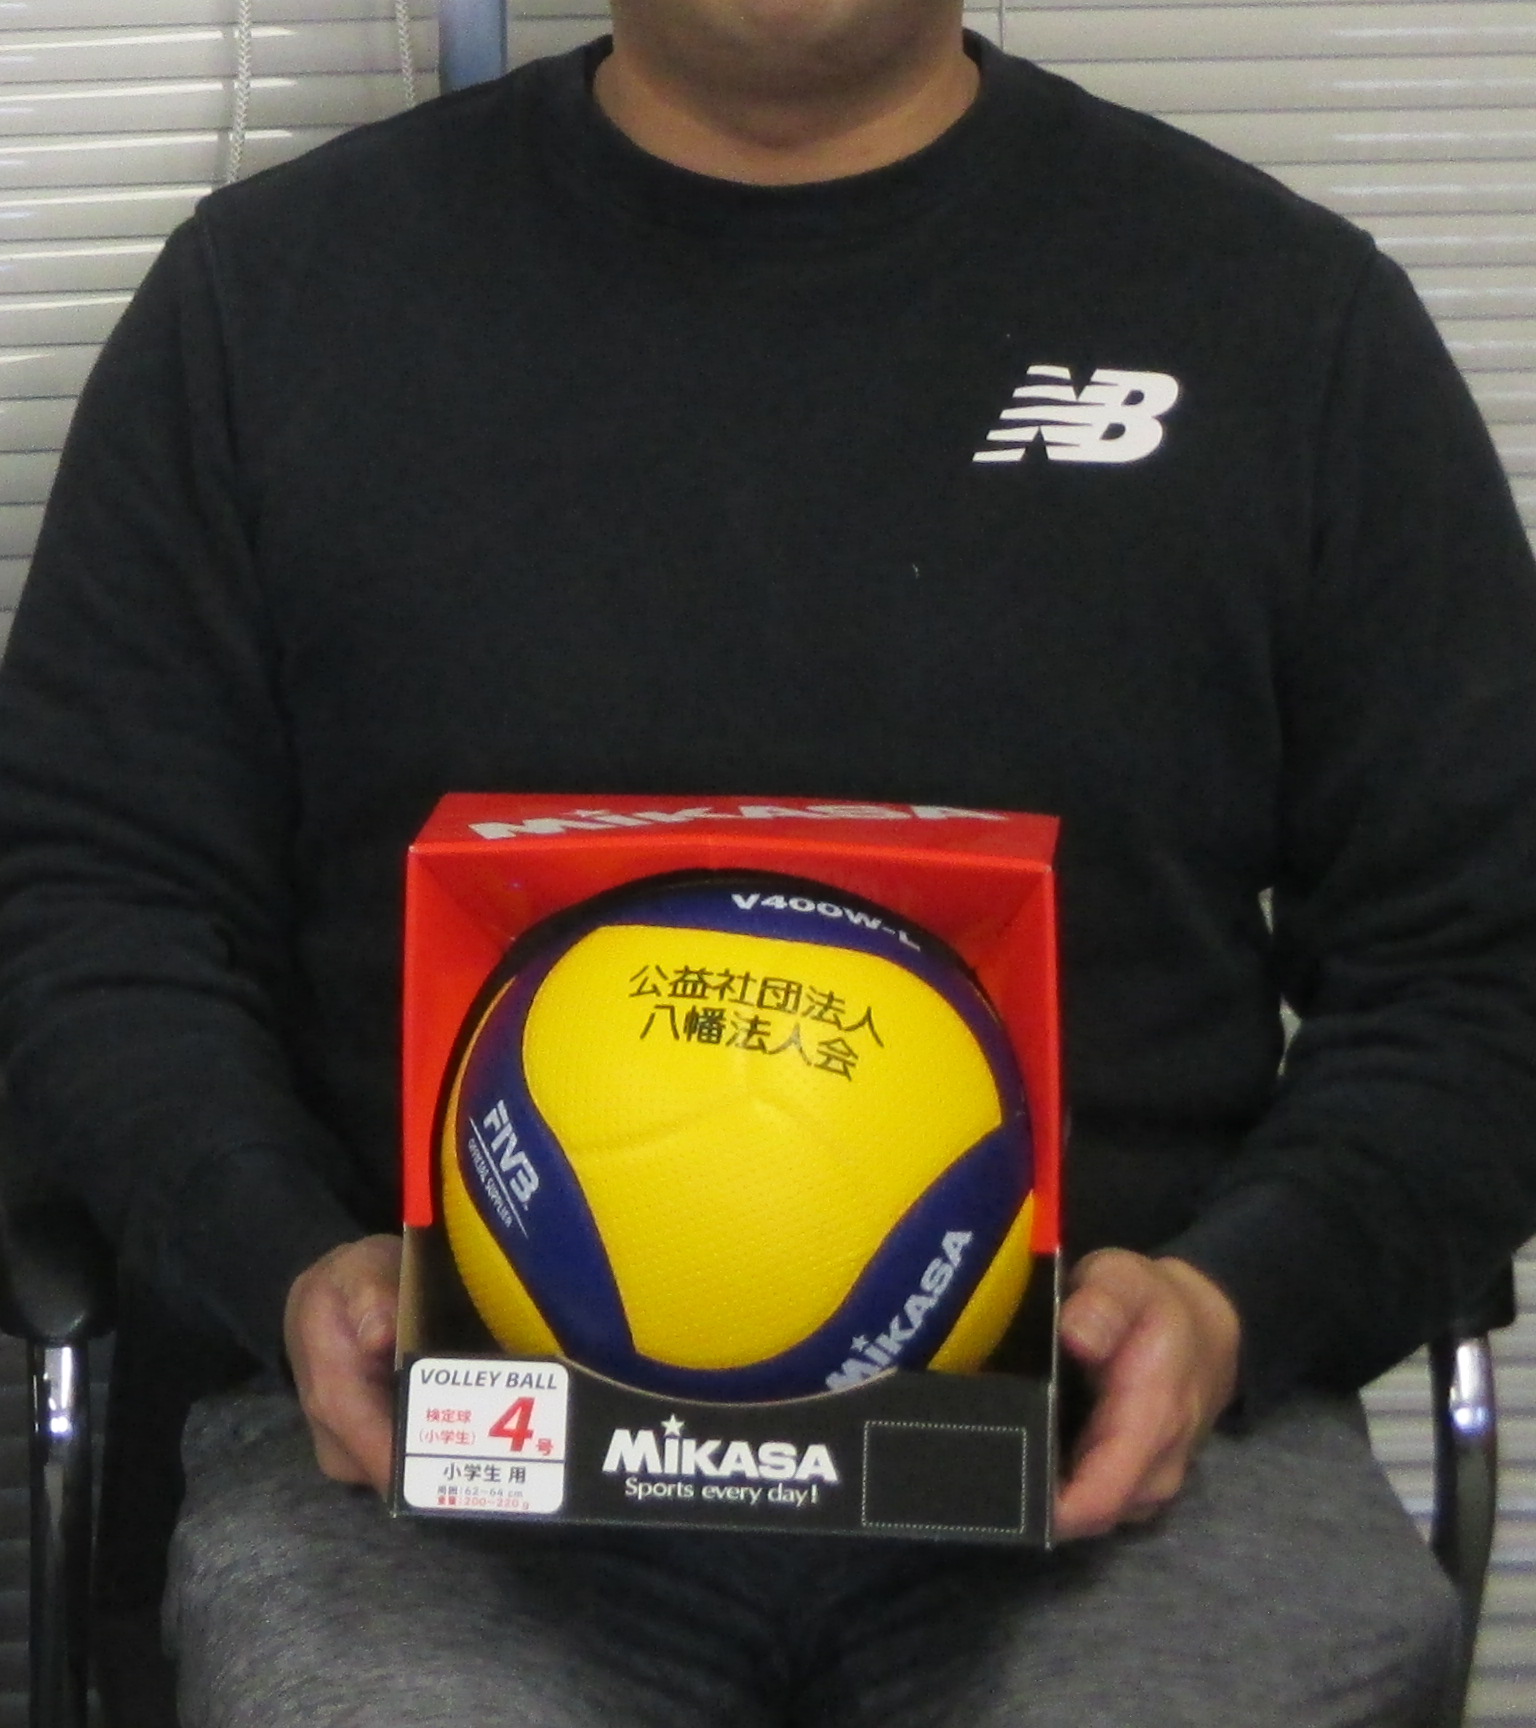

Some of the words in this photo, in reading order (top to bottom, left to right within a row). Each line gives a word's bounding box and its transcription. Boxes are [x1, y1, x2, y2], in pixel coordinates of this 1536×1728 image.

[730, 892, 921, 953] V400W-L
[628, 963, 885, 1049] 公益社団法人
[639, 1004, 859, 1082] 八幡法人会
[420, 1368, 502, 1388] VOLLEY
[506, 1371, 558, 1391] BALL
[624, 1477, 695, 1501] Sports
[702, 1482, 763, 1504] every
[768, 1481, 818, 1504] day!
